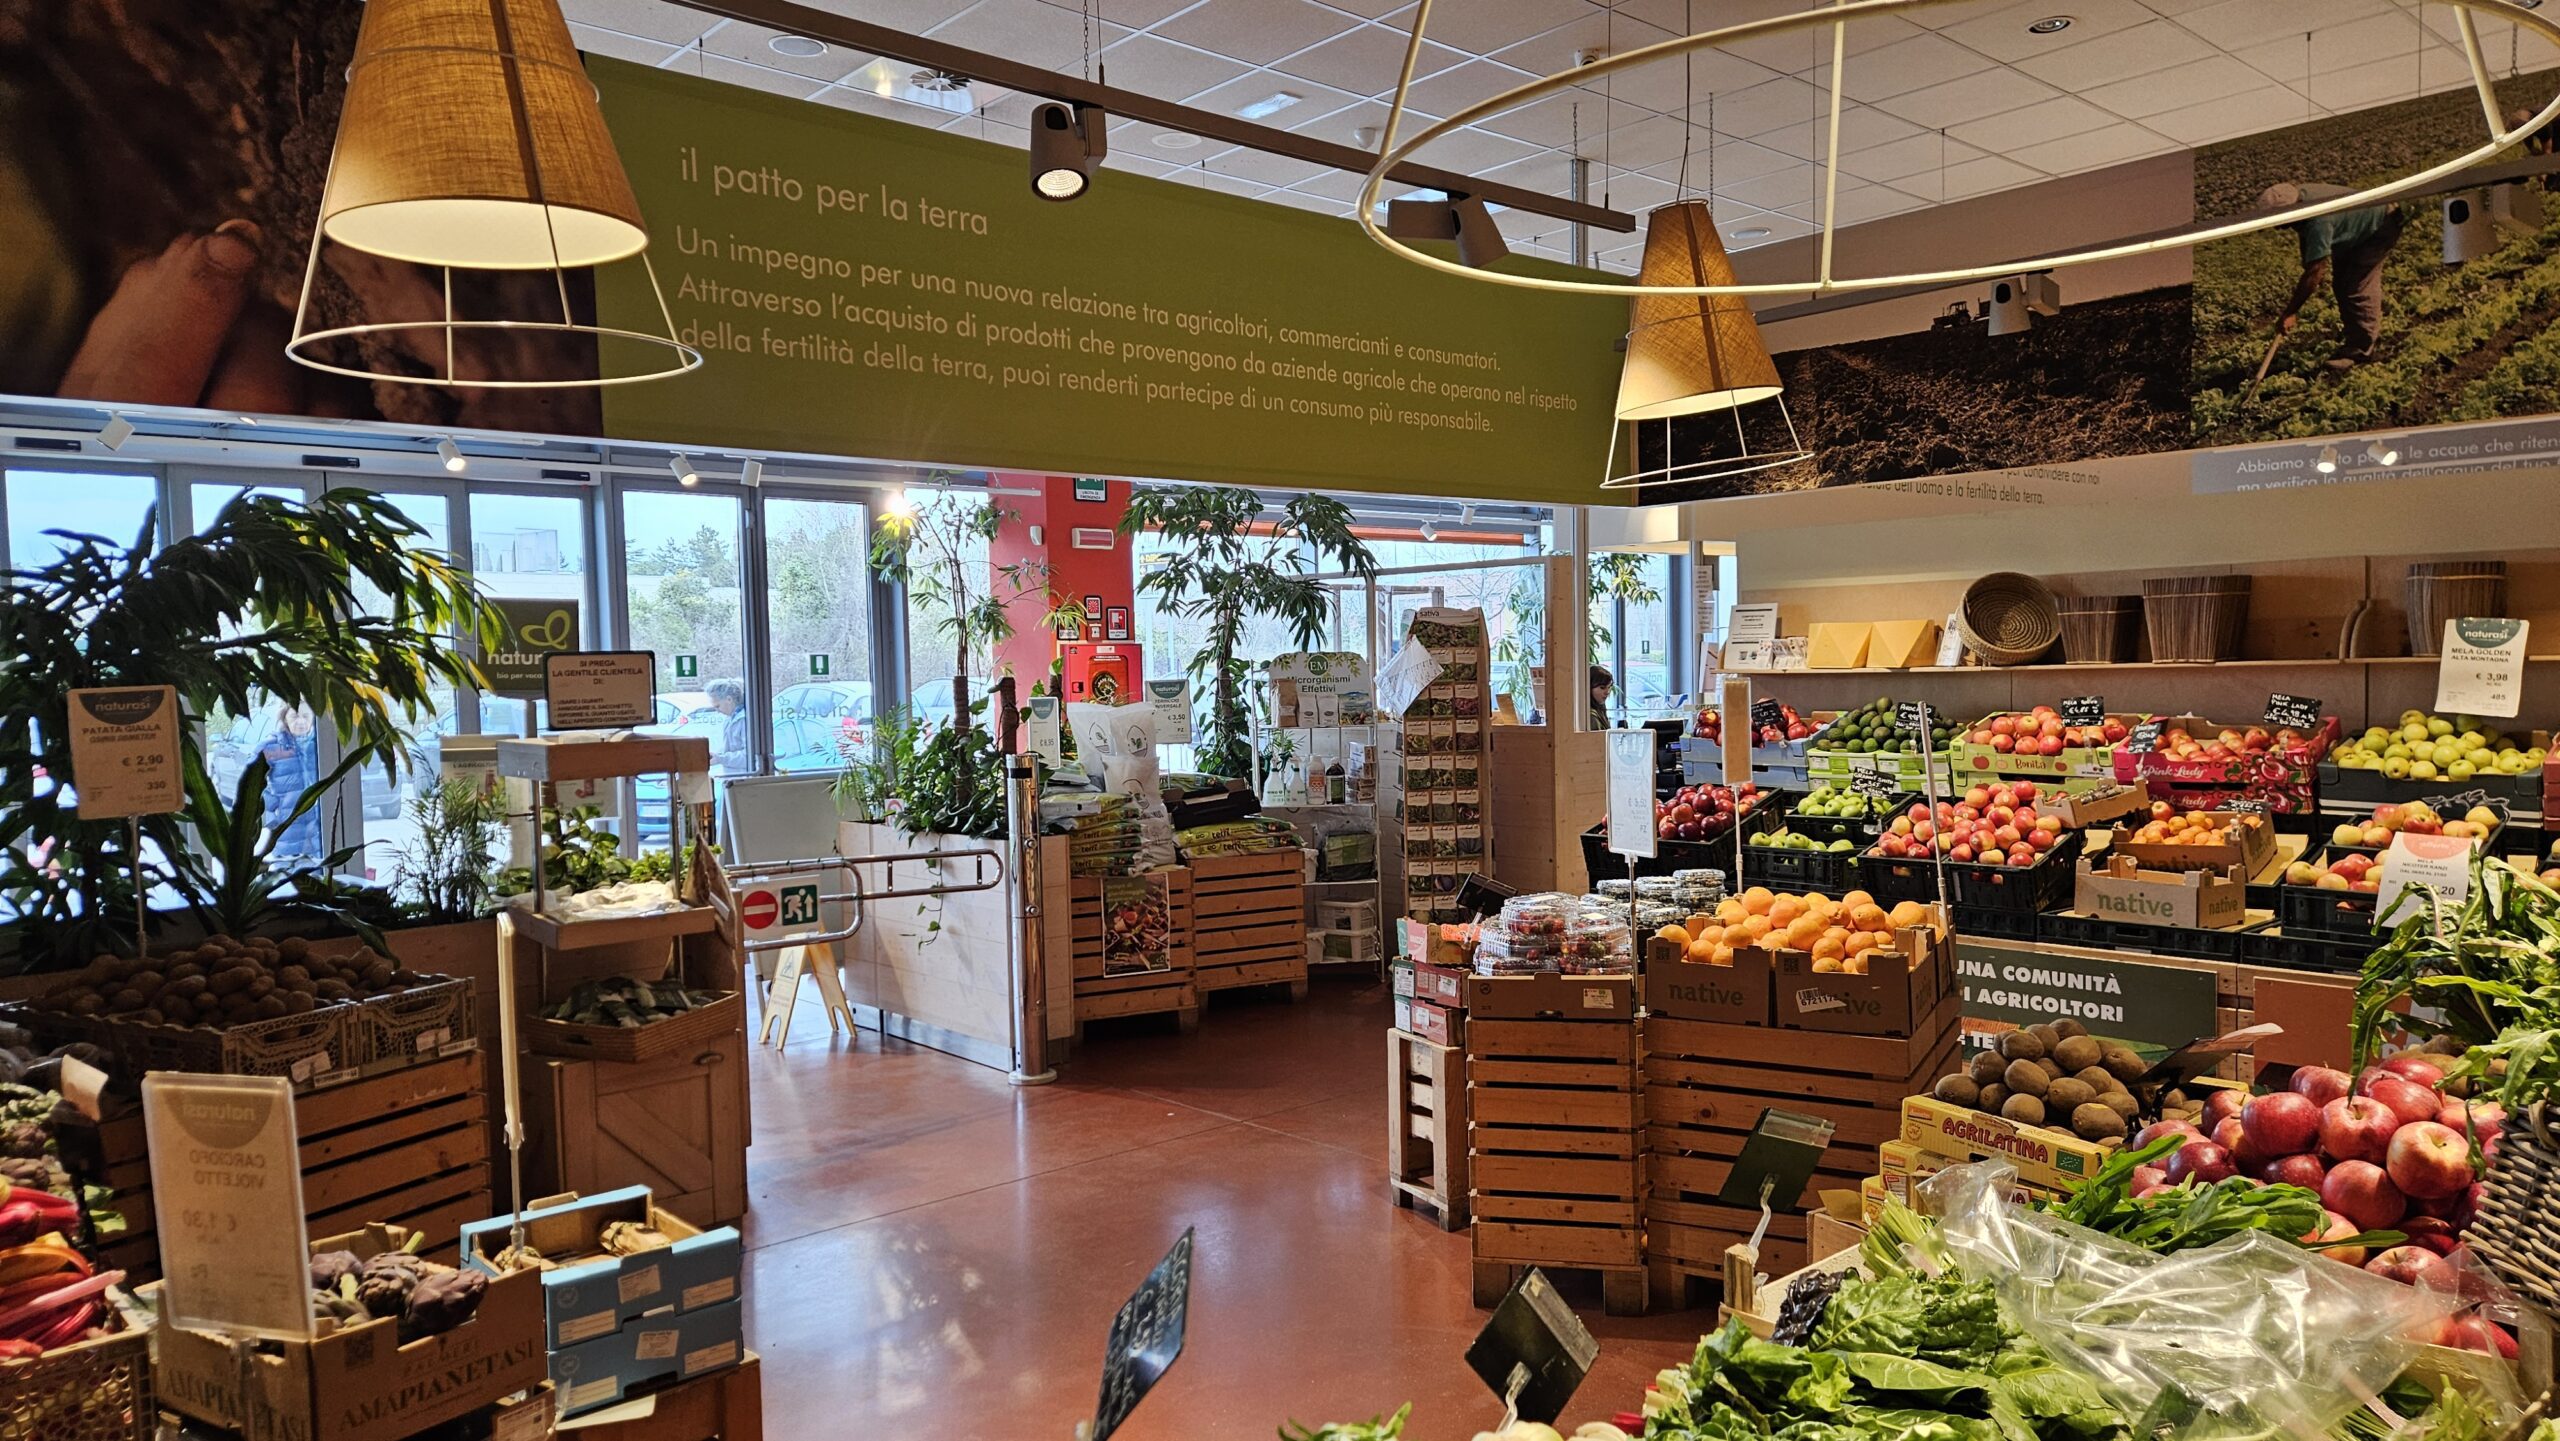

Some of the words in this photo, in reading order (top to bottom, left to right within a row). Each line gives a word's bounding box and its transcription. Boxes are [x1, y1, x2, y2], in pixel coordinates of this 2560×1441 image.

[681, 147, 698, 182] il
[713, 164, 803, 201] patto
[816, 183, 869, 215] per
[881, 184, 908, 221] la
[918, 197, 988, 235] terra
[676, 225, 718, 258] Un
[729, 233, 851, 279] impegno
[860, 263, 902, 287] per
[911, 272, 956, 294] una
[965, 279, 1033, 305] nuova
[1042, 286, 1136, 321] relazione
[1142, 302, 1168, 325] tra
[1175, 310, 1273, 344] agricoltori,
[1279, 324, 1389, 356] commercianti
[1394, 343, 1404, 358] e
[1408, 345, 1501, 371] consumatori.
[678, 272, 822, 317] Attraverso
[832, 292, 948, 334] l'acquisto
[956, 312, 977, 337] di
[986, 321, 1071, 350] prodotti
[1079, 329, 1115, 355] che
[1122, 341, 1237, 372] provengono
[1243, 351, 1265, 374] da
[1272, 356, 1337, 383] aziende
[1342, 368, 1406, 391] agricole
[1410, 374, 1436, 395] che
[1441, 382, 1501, 403] operano
[1505, 386, 1526, 405] nel
[1529, 389, 1577, 412] rispetto
[681, 318, 751, 352] della
[761, 327, 854, 364] fertilità
[863, 341, 924, 372] della
[933, 352, 995, 385] terra,
[1003, 364, 1050, 388] puoi
[1059, 369, 1138, 396] renderti
[1146, 381, 1234, 410] partecipe
[1240, 386, 1256, 408] di
[1263, 395, 1284, 411] un
[1290, 397, 1364, 420] consumo
[1369, 402, 1393, 425] più
[1399, 409, 1494, 432] responsabile.
[2236, 457, 2304, 474] Abbiamo
[2409, 446, 2423, 459] le
[2428, 444, 2479, 462] acque
[2484, 438, 2514, 453] che
[2520, 434, 2560, 450] riten
[2071, 472, 2086, 483] con
[1946, 484, 1953, 496] e
[1955, 480, 1964, 497] la
[2000, 484, 2021, 502] della
[1420, 608, 1440, 617] sativa
[487, 650, 544, 666] natur
[2451, 647, 2474, 655] MELA
[2476, 648, 2512, 657] GOLDEN
[589, 659, 616, 667] PREGA
[1309, 660, 1328, 671] EM
[552, 670, 563, 678] LA
[564, 668, 598, 677] GENTILE
[600, 667, 643, 676] CLIENTELA
[2476, 672, 2481, 680] €
[2487, 672, 2508, 682] 3,98
[1301, 685, 1336, 693] Effettivi
[81, 726, 122, 735] PATATA
[122, 757, 131, 766] €
[136, 754, 164, 765] 2,90
[2015, 757, 2048, 770] Bonita
[2144, 764, 2173, 777] Pink
[2173, 765, 2208, 779] Lady
[2441, 886, 2455, 895] 20
[2097, 892, 2174, 918] native
[2208, 896, 2238, 916] native
[2002, 965, 2122, 995] COMUNITÀ
[1669, 982, 1744, 1007] native
[1960, 986, 1971, 1002] I
[1977, 988, 2124, 1022] AGRICOLTORI
[1970, 1030, 1995, 1050] TE
[1942, 1117, 2049, 1163] AGRILATINA
